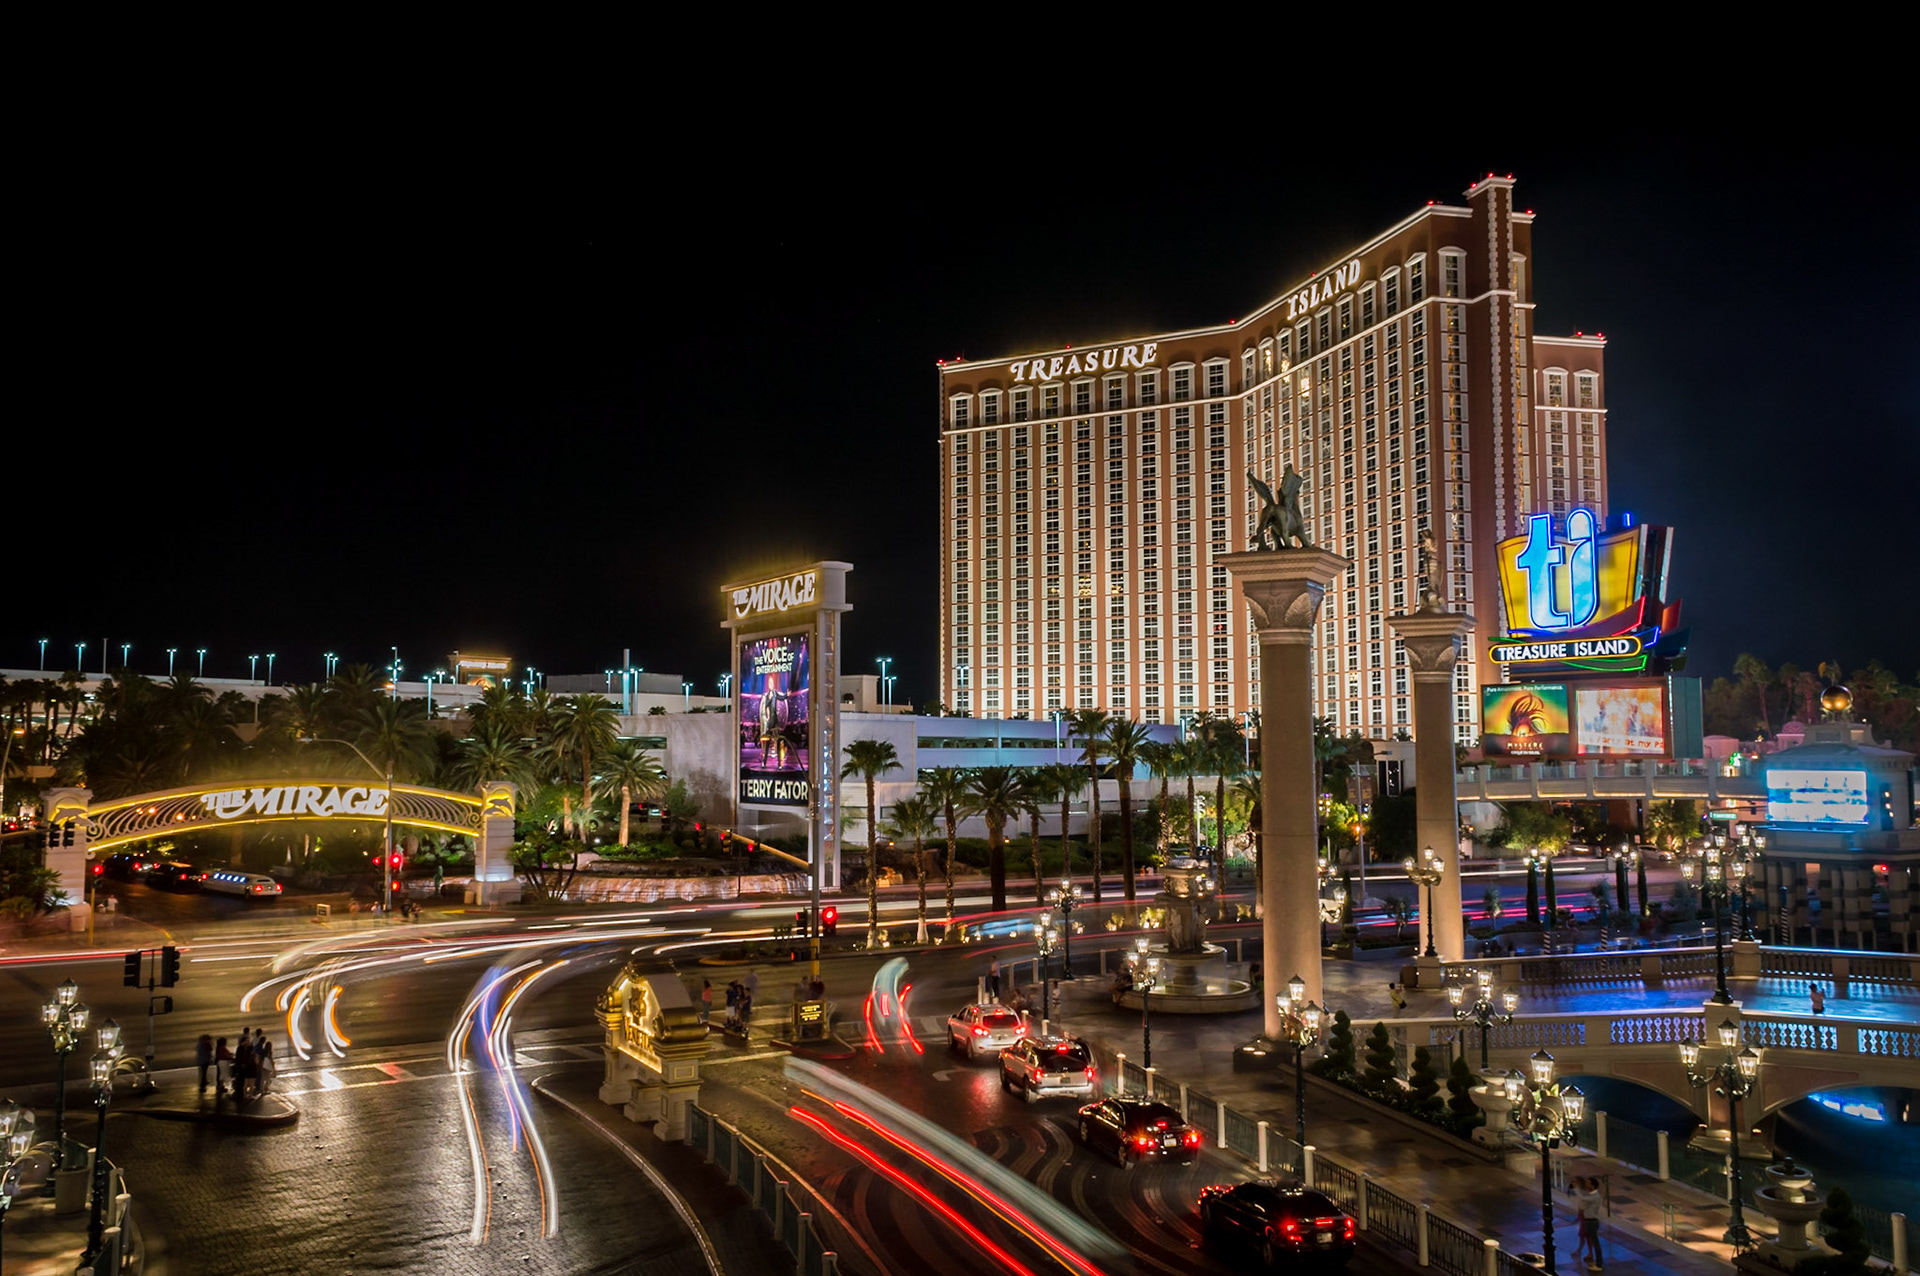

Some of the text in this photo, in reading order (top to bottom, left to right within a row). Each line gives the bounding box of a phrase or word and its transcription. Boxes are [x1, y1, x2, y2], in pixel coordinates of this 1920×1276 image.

[1010, 258, 1361, 382] TREASURE ISLAND
[1515, 508, 1599, 629] ti
[733, 572, 816, 617] THE MIRAGE
[754, 646, 794, 665] THE VOICE OF
[1498, 639, 1630, 661] TREASURE ISLAND
[756, 662, 792, 675] ENTERTAINMENT
[200, 786, 390, 819] THE MIRAGE
[741, 779, 808, 800] TERRY FATOR
